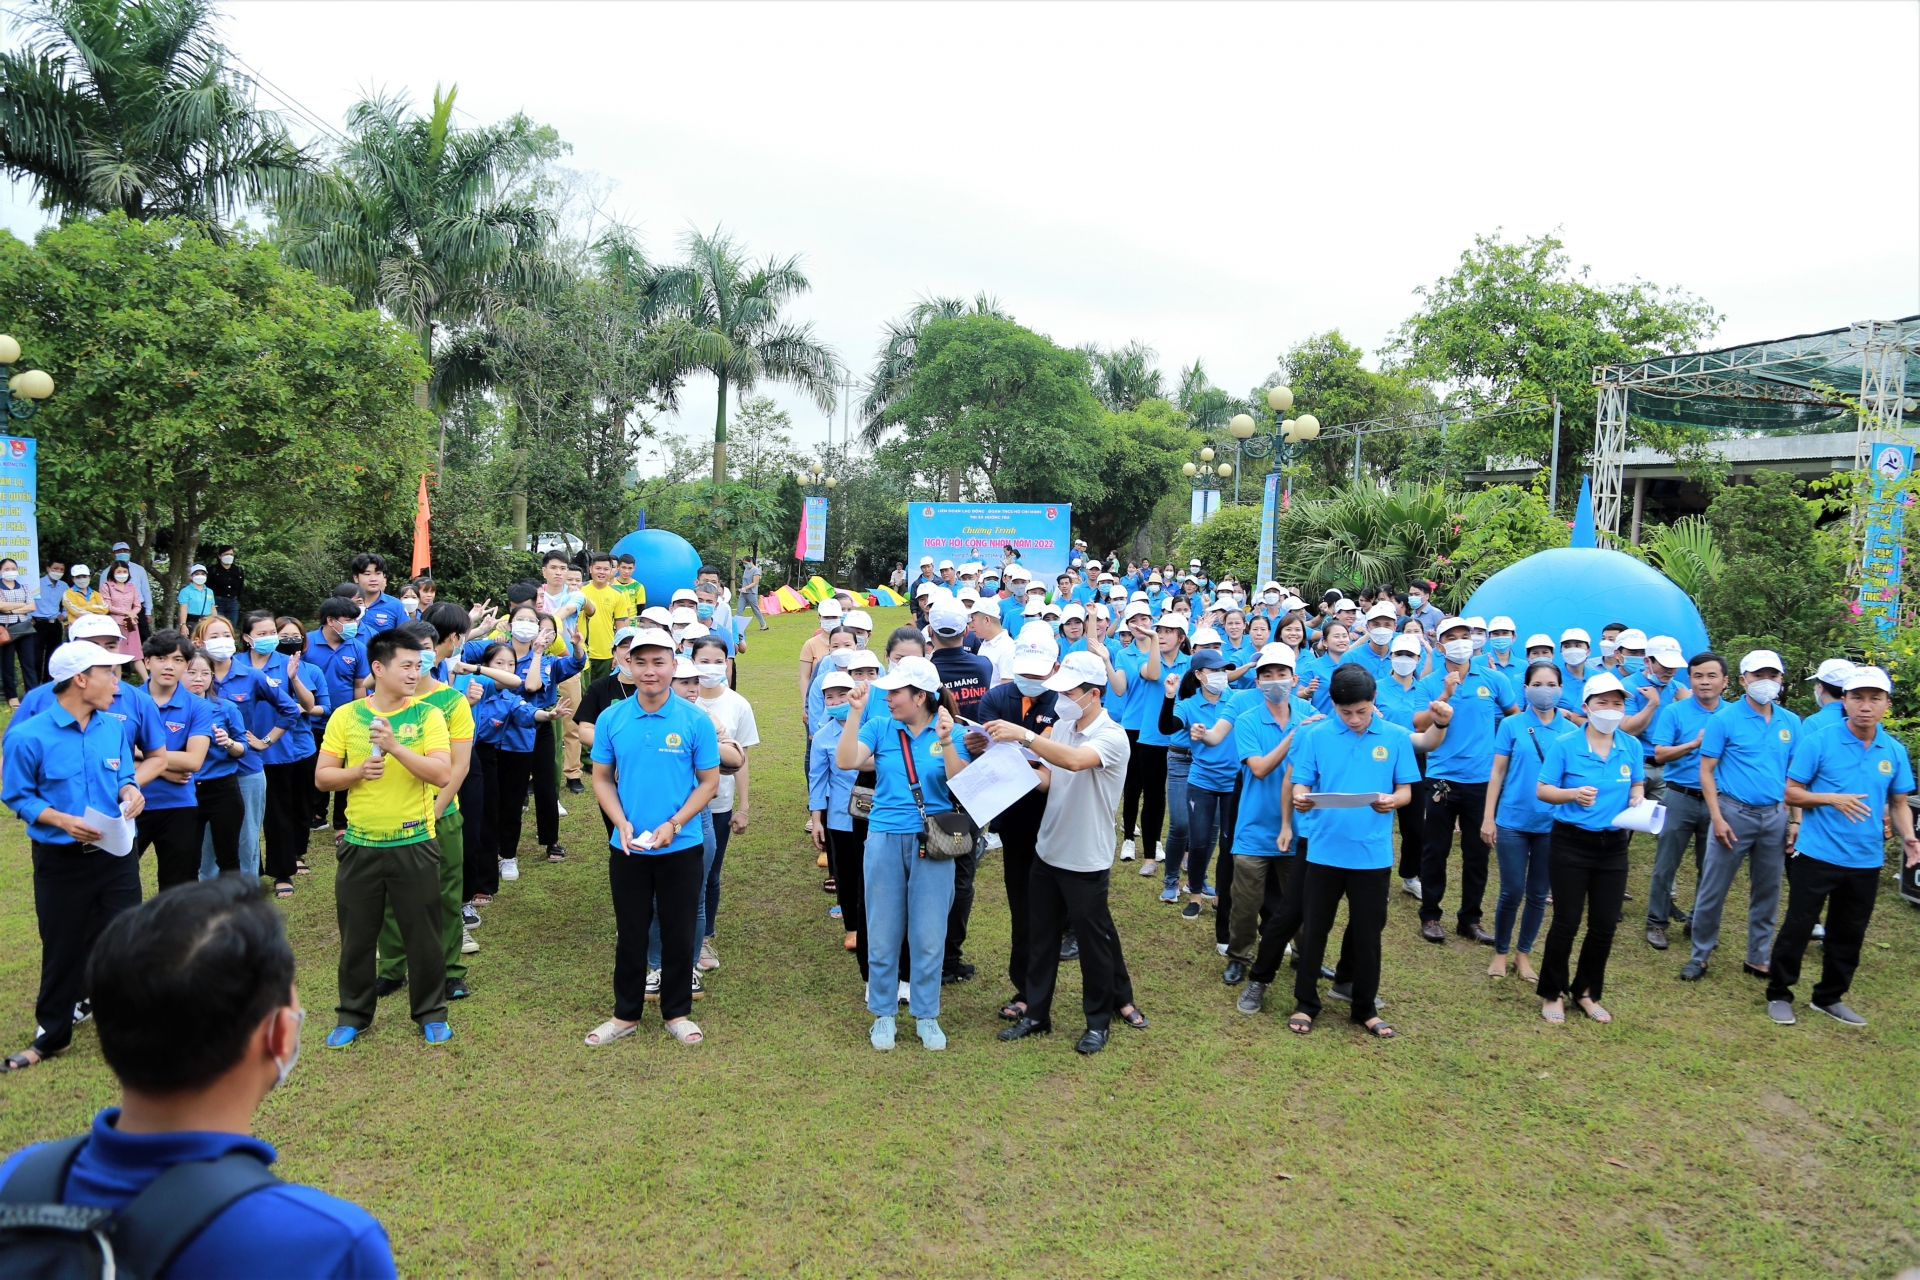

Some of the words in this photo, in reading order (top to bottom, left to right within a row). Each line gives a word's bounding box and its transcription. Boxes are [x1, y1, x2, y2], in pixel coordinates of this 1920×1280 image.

[962, 526, 992, 536] Chương
[924, 536, 946, 547] NGÀY
[949, 536, 963, 548] HỘI
[965, 537, 987, 547] CÔNG
[990, 537, 1011, 548] NHÂN
[1034, 540, 1054, 548] 2022
[954, 678, 978, 688] MĂNG
